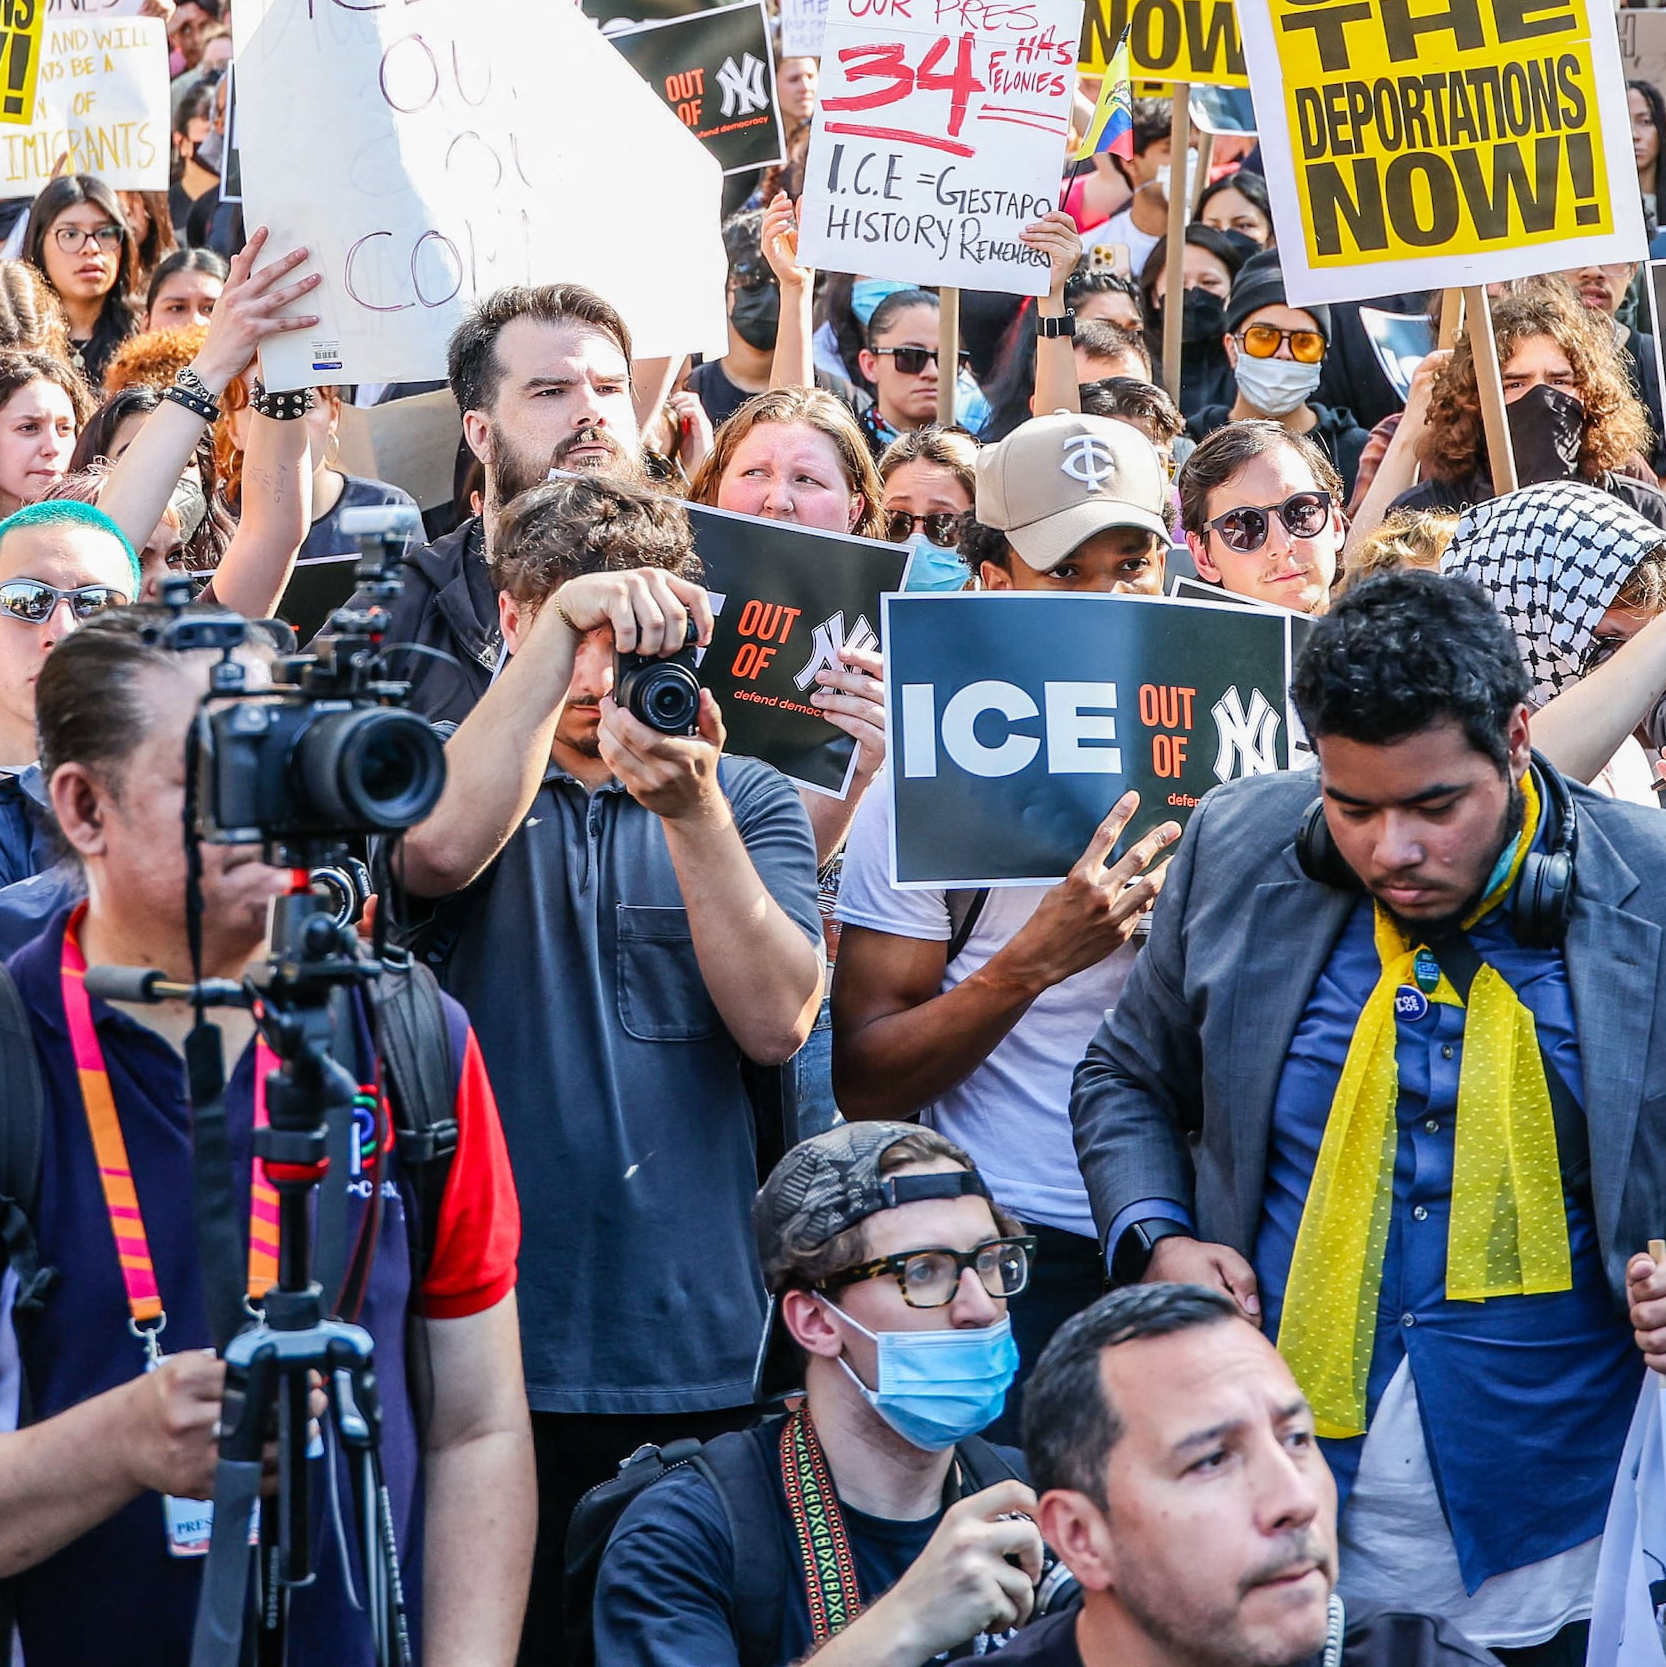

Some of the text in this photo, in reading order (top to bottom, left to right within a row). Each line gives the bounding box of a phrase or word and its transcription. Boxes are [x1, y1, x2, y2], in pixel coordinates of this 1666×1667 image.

[50, 28, 149, 55] AND WILL
[1015, 24, 1077, 66] HAS
[70, 53, 115, 78] BE A
[665, 68, 704, 103] OUT
[820, 32, 1066, 137] 34 FELONIES
[72, 91, 98, 117] OF
[678, 99, 703, 127] OF
[720, 114, 769, 134] democracy
[1295, 53, 1588, 161] DEPORTATIONS
[2, 121, 156, 182] IMIGRANTS
[827, 144, 1052, 219] I.C.E GESTAPO
[1305, 132, 1601, 257] NOW!
[826, 205, 953, 261] HISTORY
[737, 599, 802, 644] OUT
[731, 643, 778, 681] OF
[733, 688, 779, 708] defend
[901, 679, 1122, 779] ICE
[1138, 684, 1196, 731] OUT
[1152, 734, 1188, 779] OF
[358, 867, 371, 897] Canon
